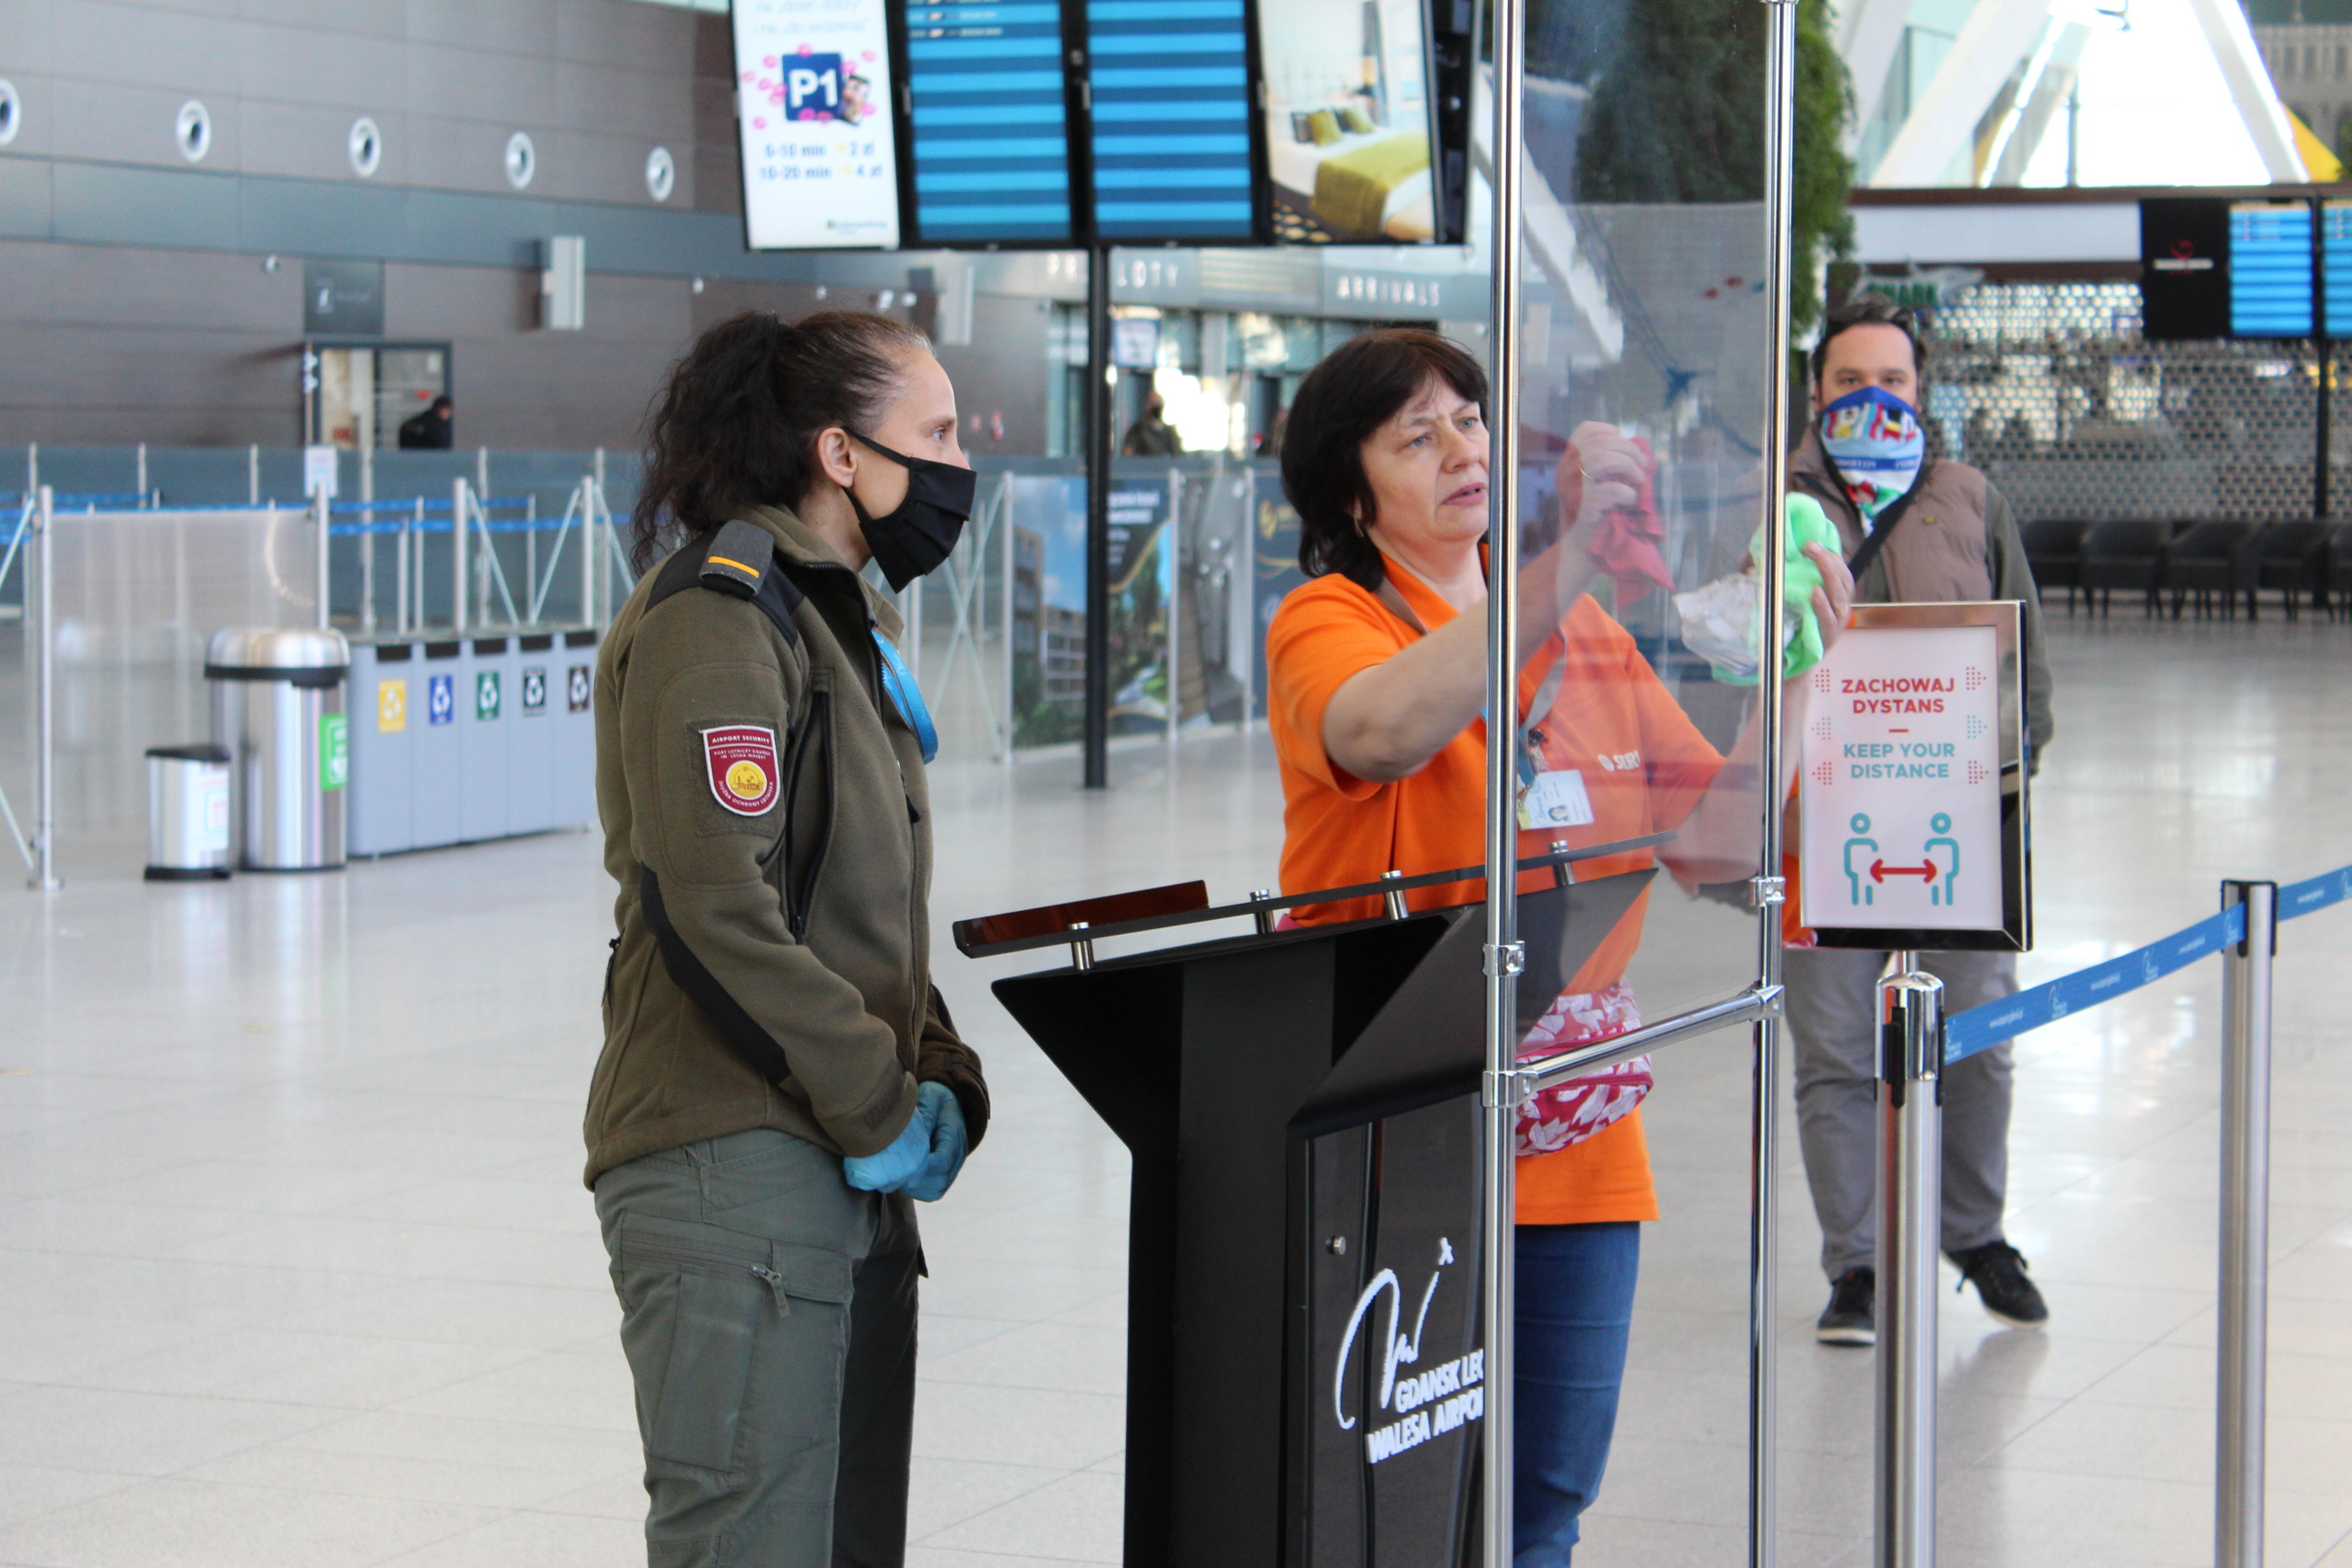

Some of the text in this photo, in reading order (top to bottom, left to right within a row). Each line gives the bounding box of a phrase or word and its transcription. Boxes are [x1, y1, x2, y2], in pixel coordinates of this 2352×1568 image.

[789, 68, 838, 108] P1
[765, 143, 797, 159] 0-10
[800, 143, 827, 157] min
[848, 140, 858, 156] 2
[760, 165, 801, 181] 10-20
[805, 164, 833, 179] min
[856, 163, 866, 177] 4
[1337, 275, 1440, 307] ARRIVALS
[1841, 678, 1955, 693] ZACHOWAJ
[1853, 699, 1945, 714] DYSTANS
[712, 736, 770, 744] AIRPORT SECURITY
[1843, 742, 1955, 759] KEEP YOUR
[1850, 763, 1950, 779] DISTANCE
[731, 799, 760, 807] OCHRONY
[1395, 1359, 1461, 1414] GDANSK
[1365, 1411, 1432, 1465] WALESA
